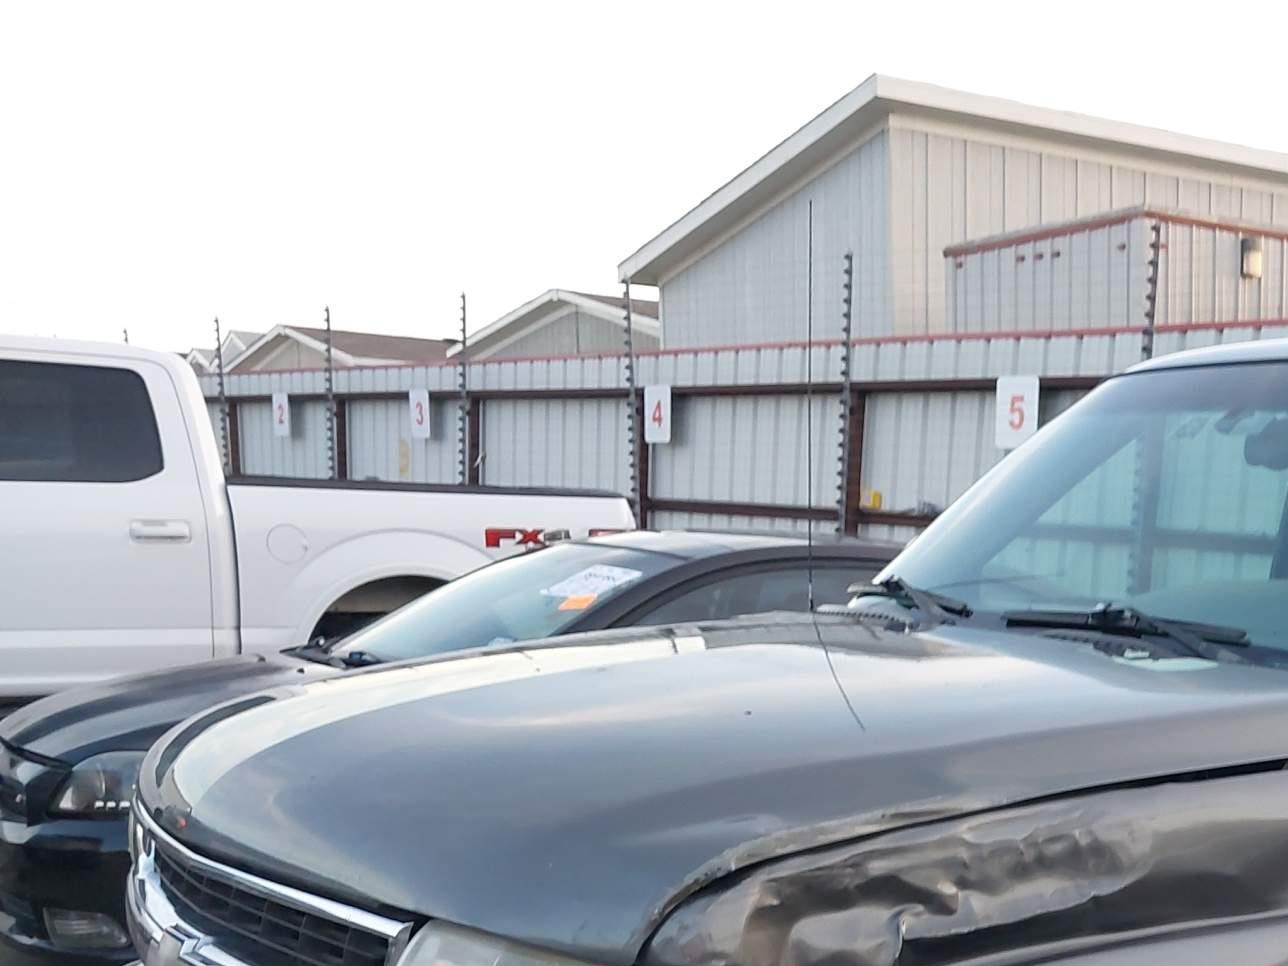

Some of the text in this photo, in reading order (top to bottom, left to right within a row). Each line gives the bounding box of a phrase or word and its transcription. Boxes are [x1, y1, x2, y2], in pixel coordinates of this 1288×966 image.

[277, 403, 285, 425] 2
[415, 402, 425, 425] 3
[652, 399, 663, 428] 4
[1009, 395, 1025, 432] 5
